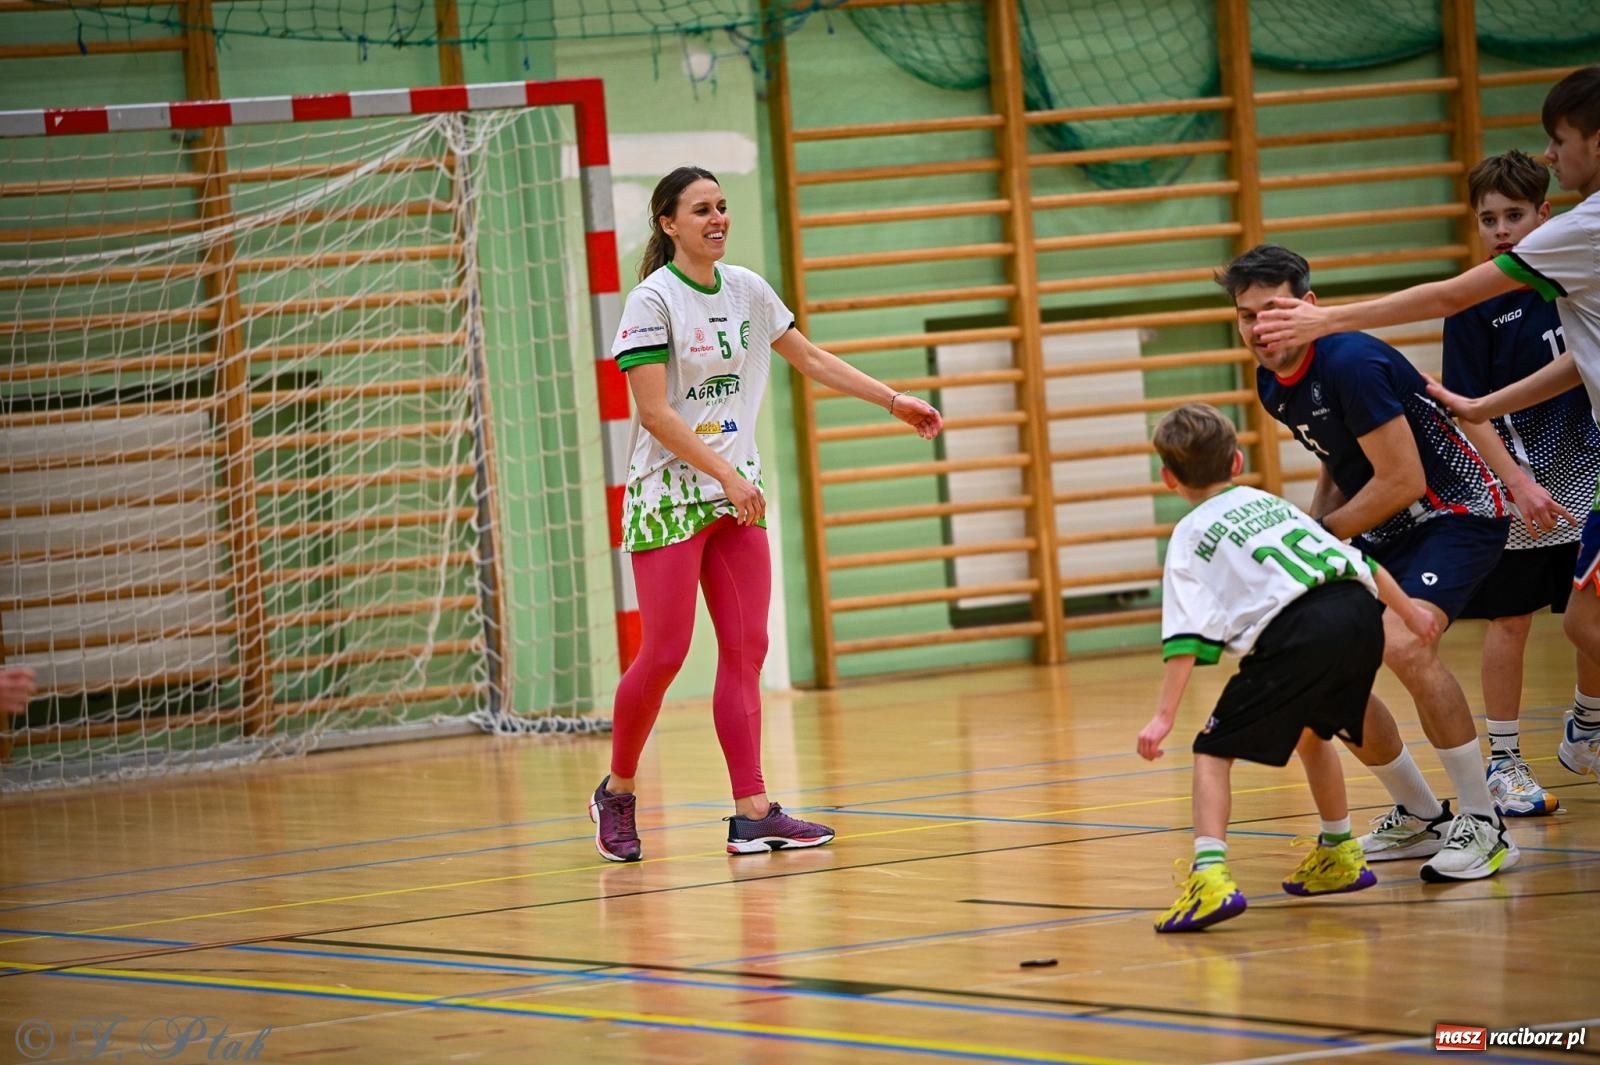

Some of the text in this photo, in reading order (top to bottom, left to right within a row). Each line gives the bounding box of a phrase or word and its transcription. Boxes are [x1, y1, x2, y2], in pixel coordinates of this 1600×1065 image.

[717, 331, 732, 359] 5
[1194, 522, 1229, 563] KLUB
[1251, 528, 1358, 588] 16
